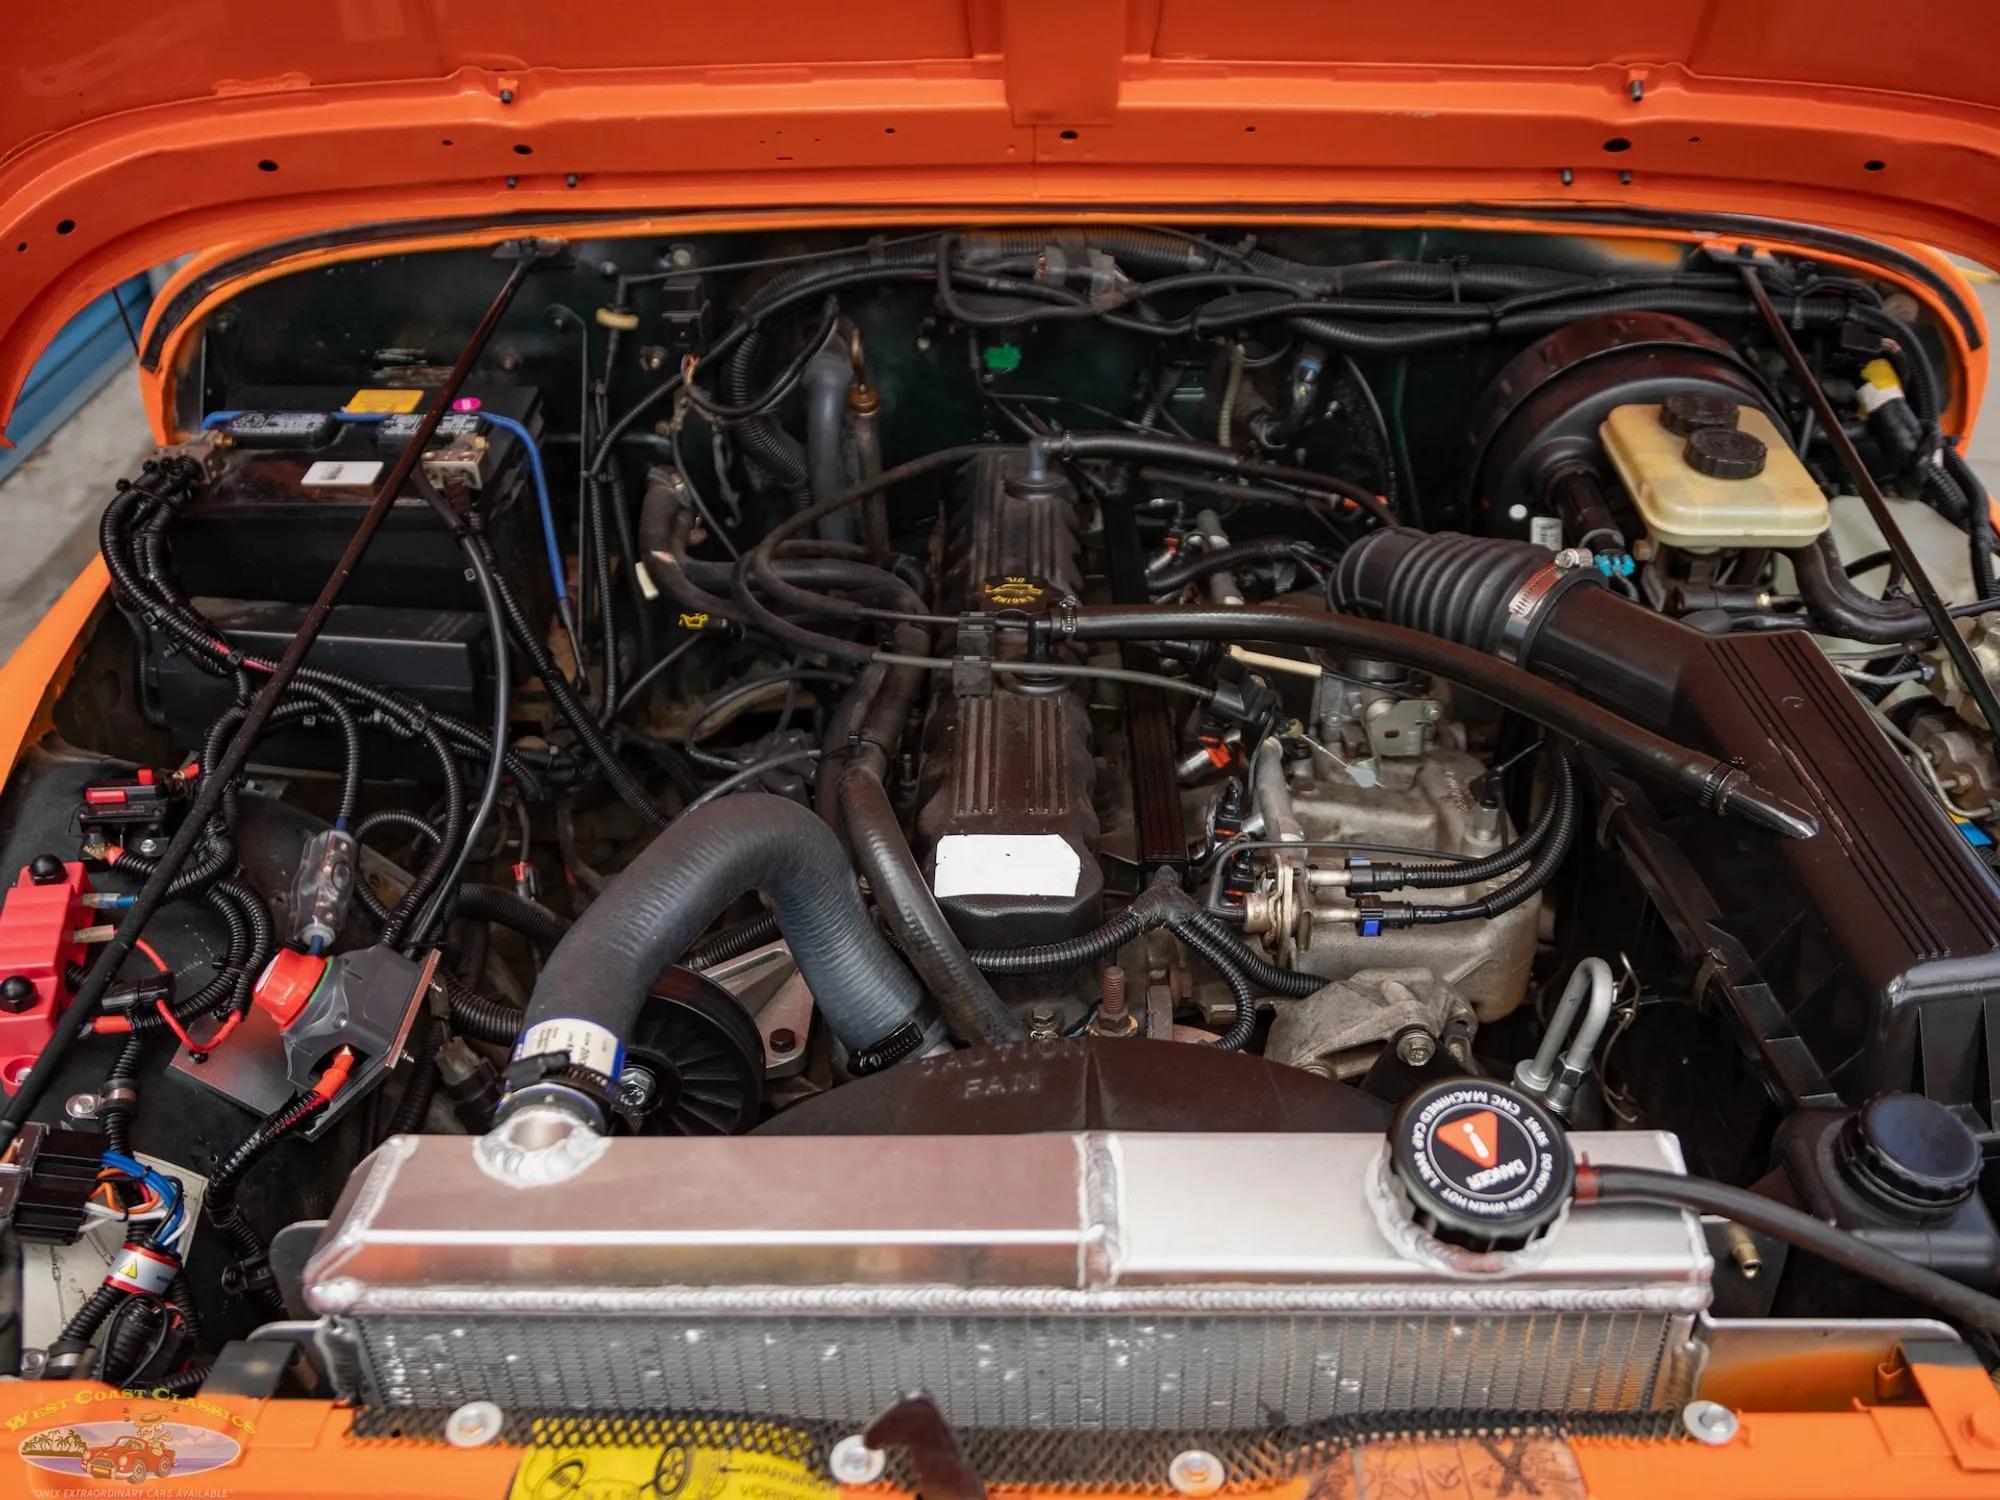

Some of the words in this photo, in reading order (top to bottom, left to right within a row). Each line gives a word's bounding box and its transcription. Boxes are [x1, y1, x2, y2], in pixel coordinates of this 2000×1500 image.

[991, 595, 1035, 604] ENGINE
[963, 1071, 1040, 1099] FAN
[1419, 1090, 1488, 1123] MACHINED
[1490, 1093, 1521, 1116] CNC
[1411, 1122, 1427, 1150] CAP
[1540, 1153, 1552, 1170] DO
[1465, 1158, 1527, 1192] DANGER
[1534, 1170, 1550, 1194] NOT
[1440, 1187, 1467, 1208] HOT
[1467, 1199, 1508, 1214] WHEN
[1507, 1188, 1538, 1211] OPEN
